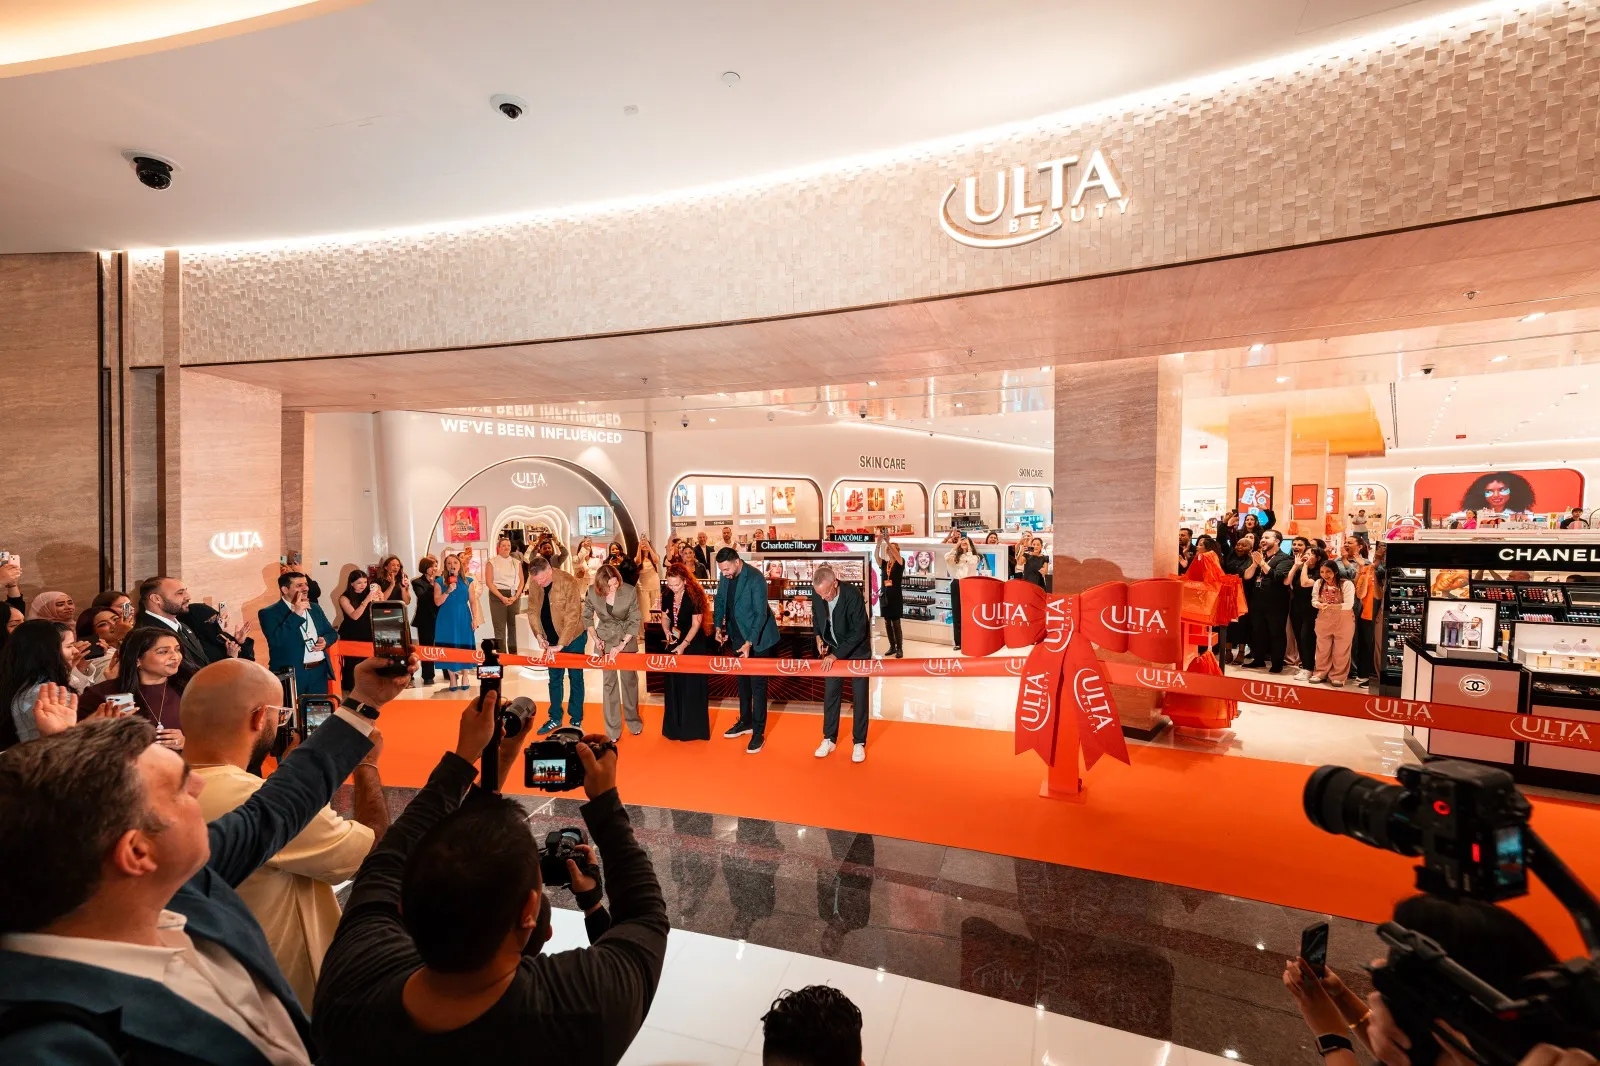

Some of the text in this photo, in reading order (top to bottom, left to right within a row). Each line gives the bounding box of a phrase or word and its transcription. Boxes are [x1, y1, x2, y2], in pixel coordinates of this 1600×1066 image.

[965, 148, 1121, 225] ULTA
[1008, 198, 1130, 233] BEAUTY
[440, 418, 622, 443] WE'VE BEEN INFLUENCED
[859, 455, 906, 470] SKIN CARE
[516, 472, 546, 484] ULTA
[218, 531, 263, 550] ULTA
[834, 533, 863, 541] LANCÔME
[1498, 548, 1600, 562] CHANEL
[981, 602, 1028, 622] ULTA
[1043, 598, 1065, 643] ULTA
[1111, 605, 1166, 629] ULTA
[423, 647, 447, 657] ULTA
[650, 655, 677, 666] ULTA
[713, 657, 742, 668] ULTA
[781, 659, 811, 669] ULTA
[852, 659, 884, 670] ULTA
[928, 658, 963, 670] ULTA
[1143, 668, 1186, 686] ULTA
[1020, 673, 1045, 723] ULTA
[1250, 682, 1300, 701] ULTA
[1081, 675, 1114, 730] ULTA
[1374, 698, 1432, 719] ULTA
[1521, 716, 1590, 740] ULTA
